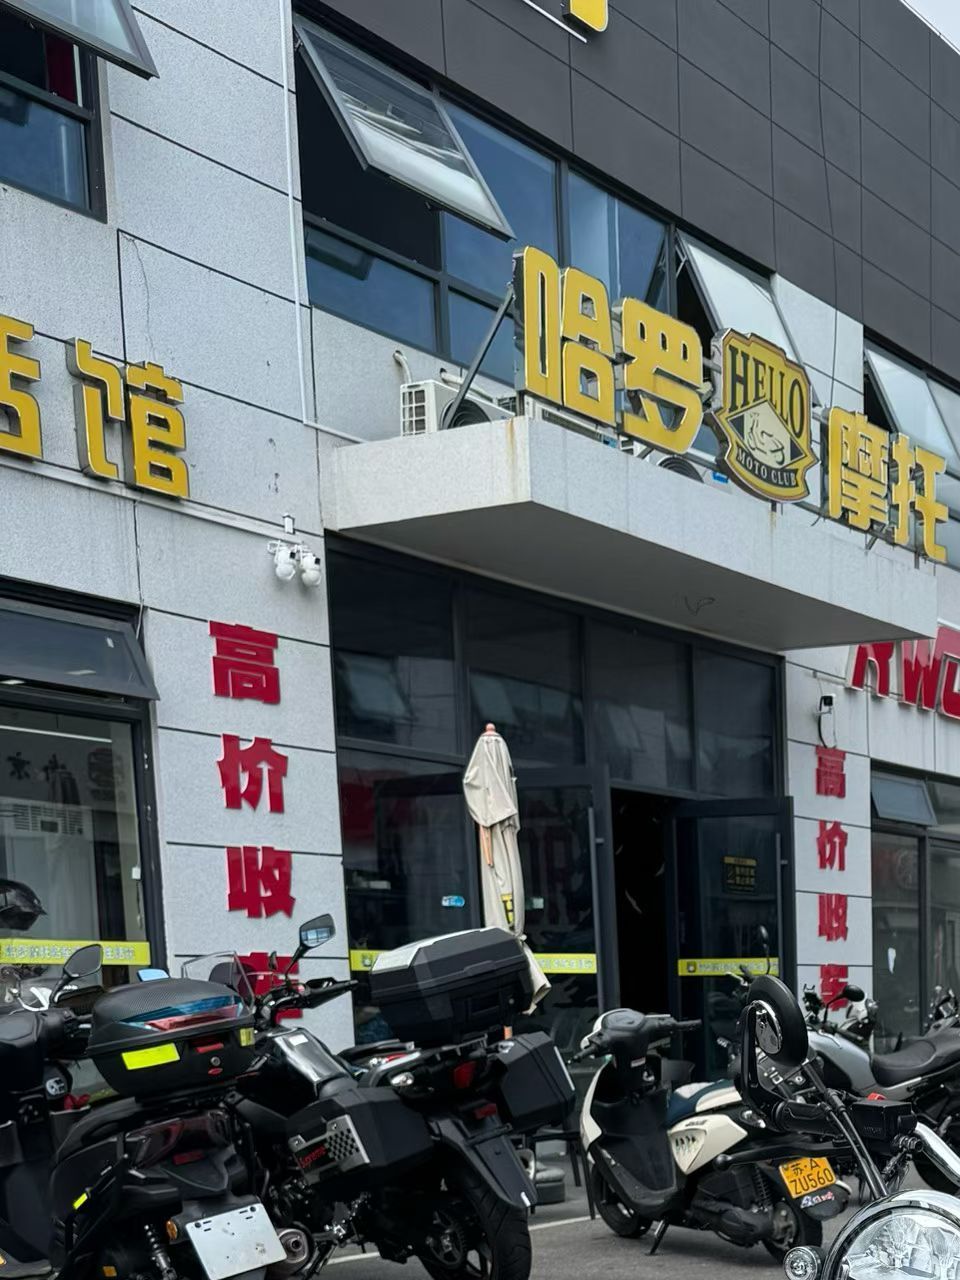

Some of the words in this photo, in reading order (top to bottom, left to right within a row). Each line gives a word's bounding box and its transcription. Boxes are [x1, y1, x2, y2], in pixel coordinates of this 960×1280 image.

[522, 246, 704, 455] 哈罗
[829, 406, 949, 563] 摩托
[728, 344, 805, 439] HELLO
[736, 448, 768, 479] MOTO
[771, 469, 797, 487] CLUB
[789, 1167, 834, 1195] ZU560
